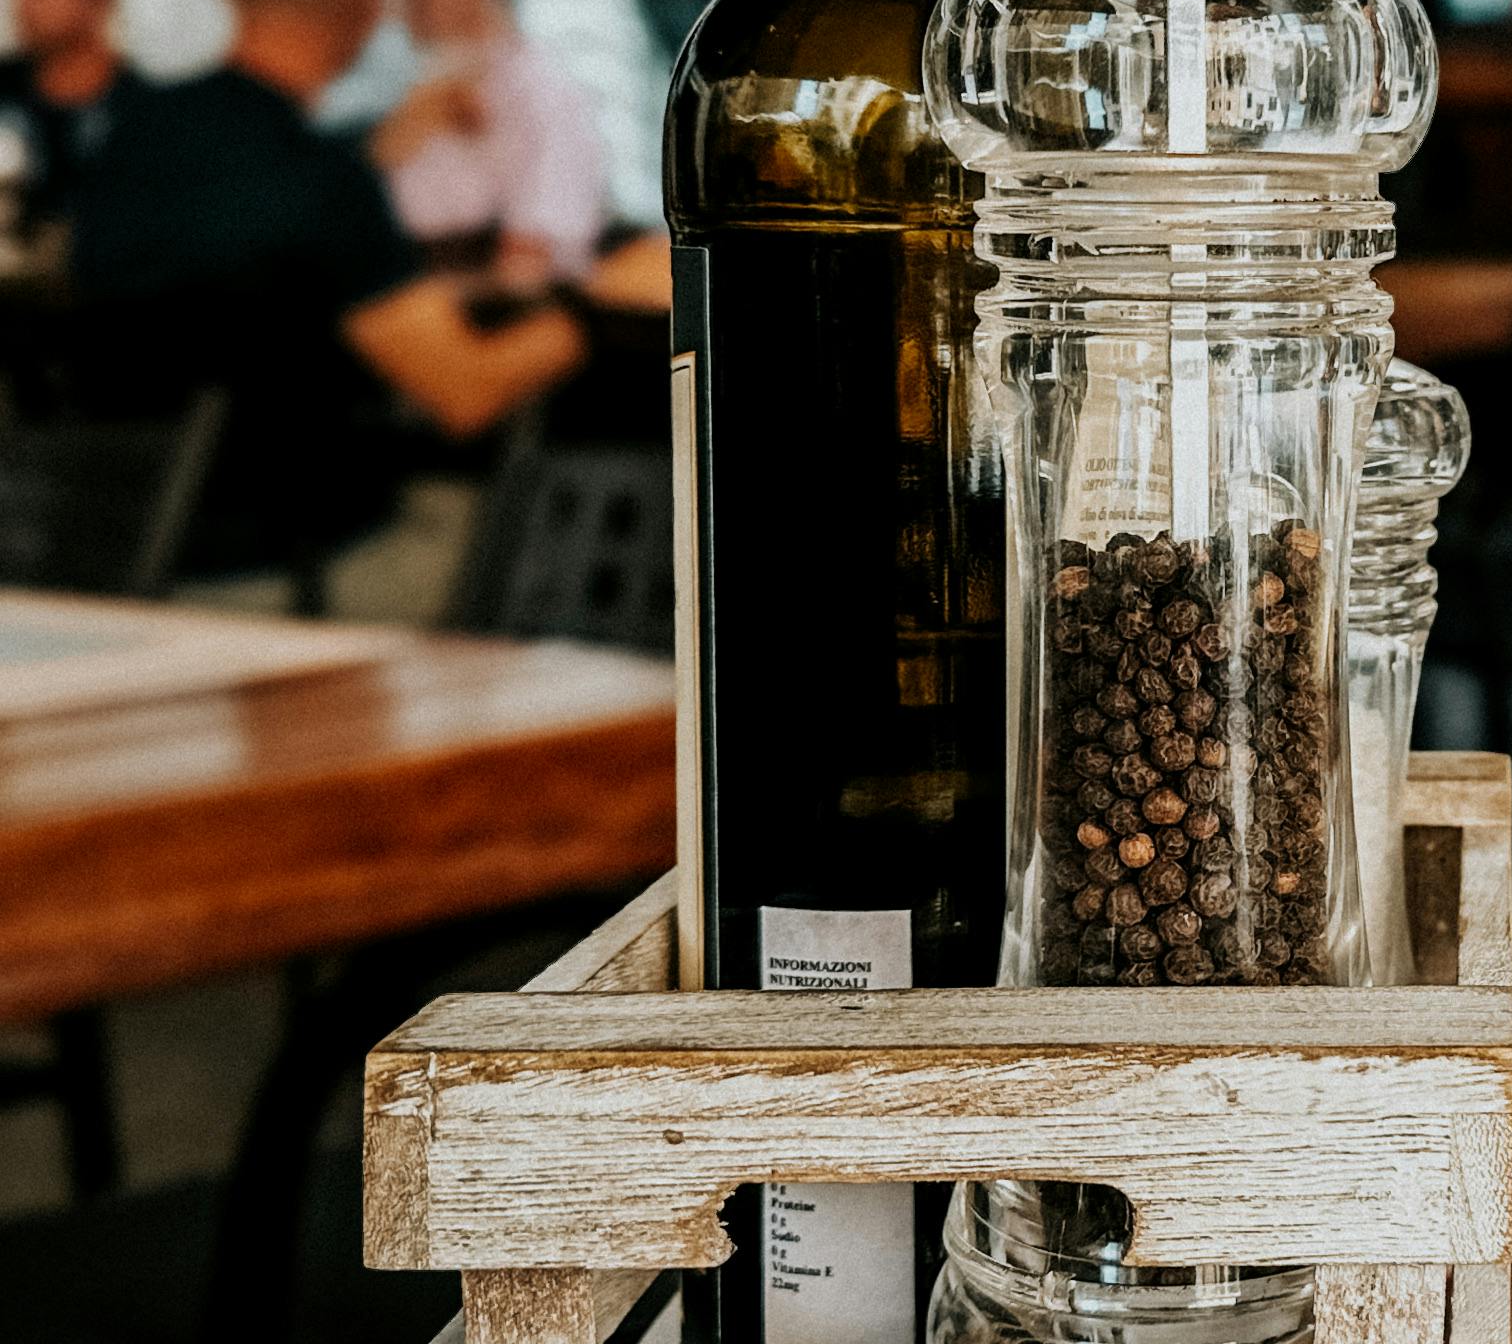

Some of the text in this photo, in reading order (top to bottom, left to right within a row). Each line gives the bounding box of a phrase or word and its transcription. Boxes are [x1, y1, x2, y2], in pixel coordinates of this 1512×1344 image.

[769, 956, 872, 973] INFORMAZIONI
[770, 973, 867, 989] NUTRIZIONALI
[771, 1197, 816, 1212] Proteine
[771, 1229, 801, 1243] Sodio
[772, 1261, 835, 1277] Vitamina E
